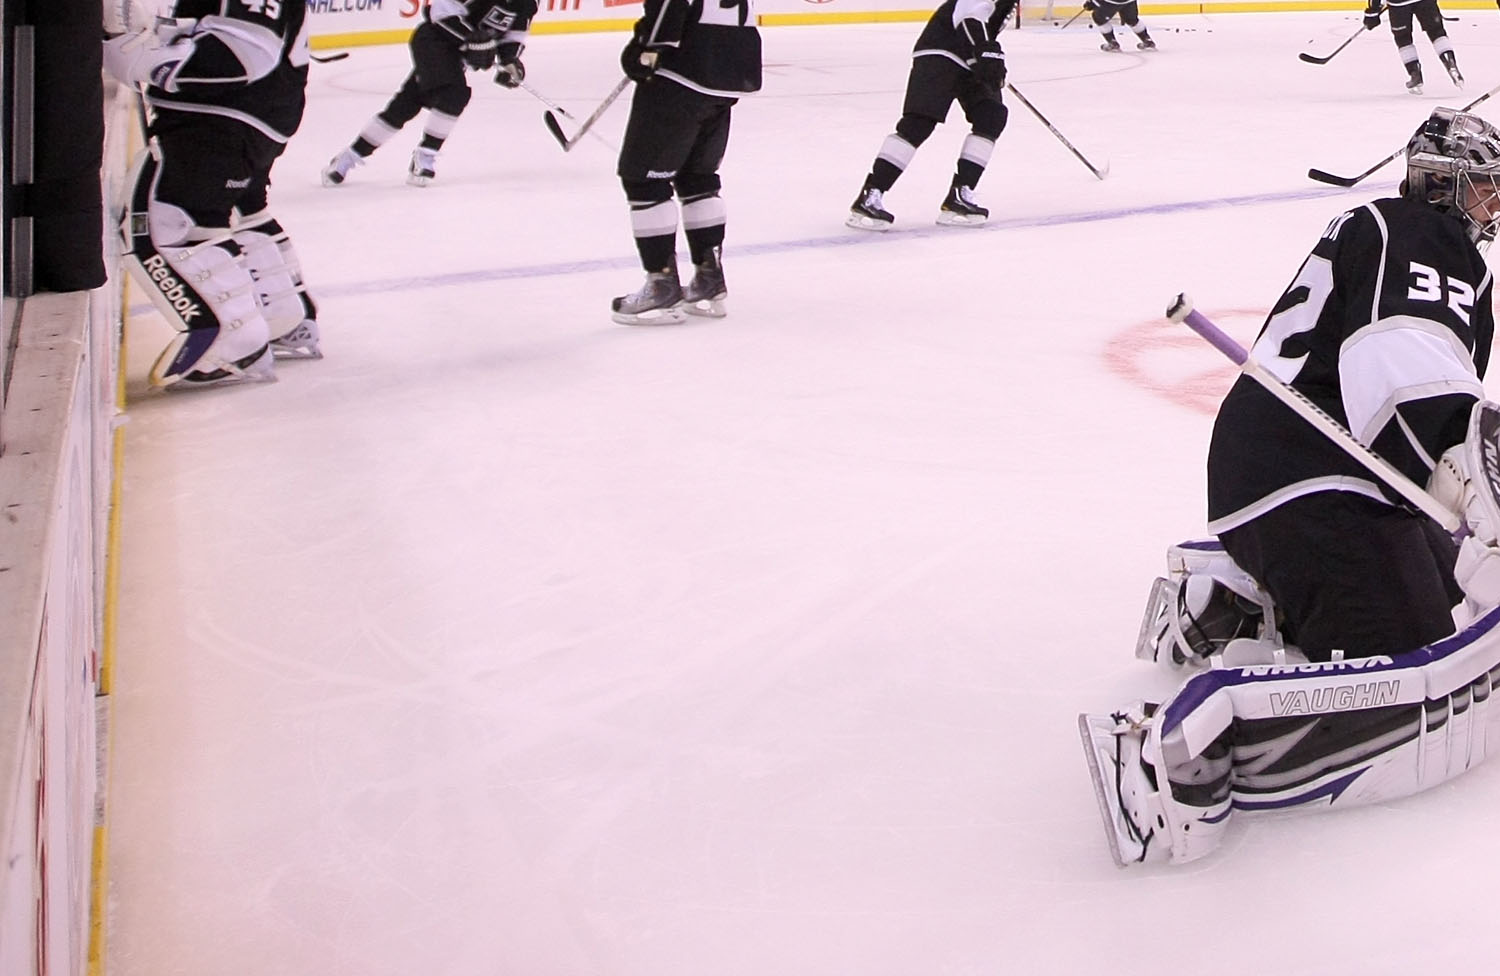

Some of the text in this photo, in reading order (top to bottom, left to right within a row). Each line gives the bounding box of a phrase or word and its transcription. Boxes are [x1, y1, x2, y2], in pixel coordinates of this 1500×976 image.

[143, 253, 201, 323] Reebok
[1243, 254, 1335, 385] 2
[1407, 260, 1477, 326] 32
[1269, 679, 1401, 717] VAUGHN
